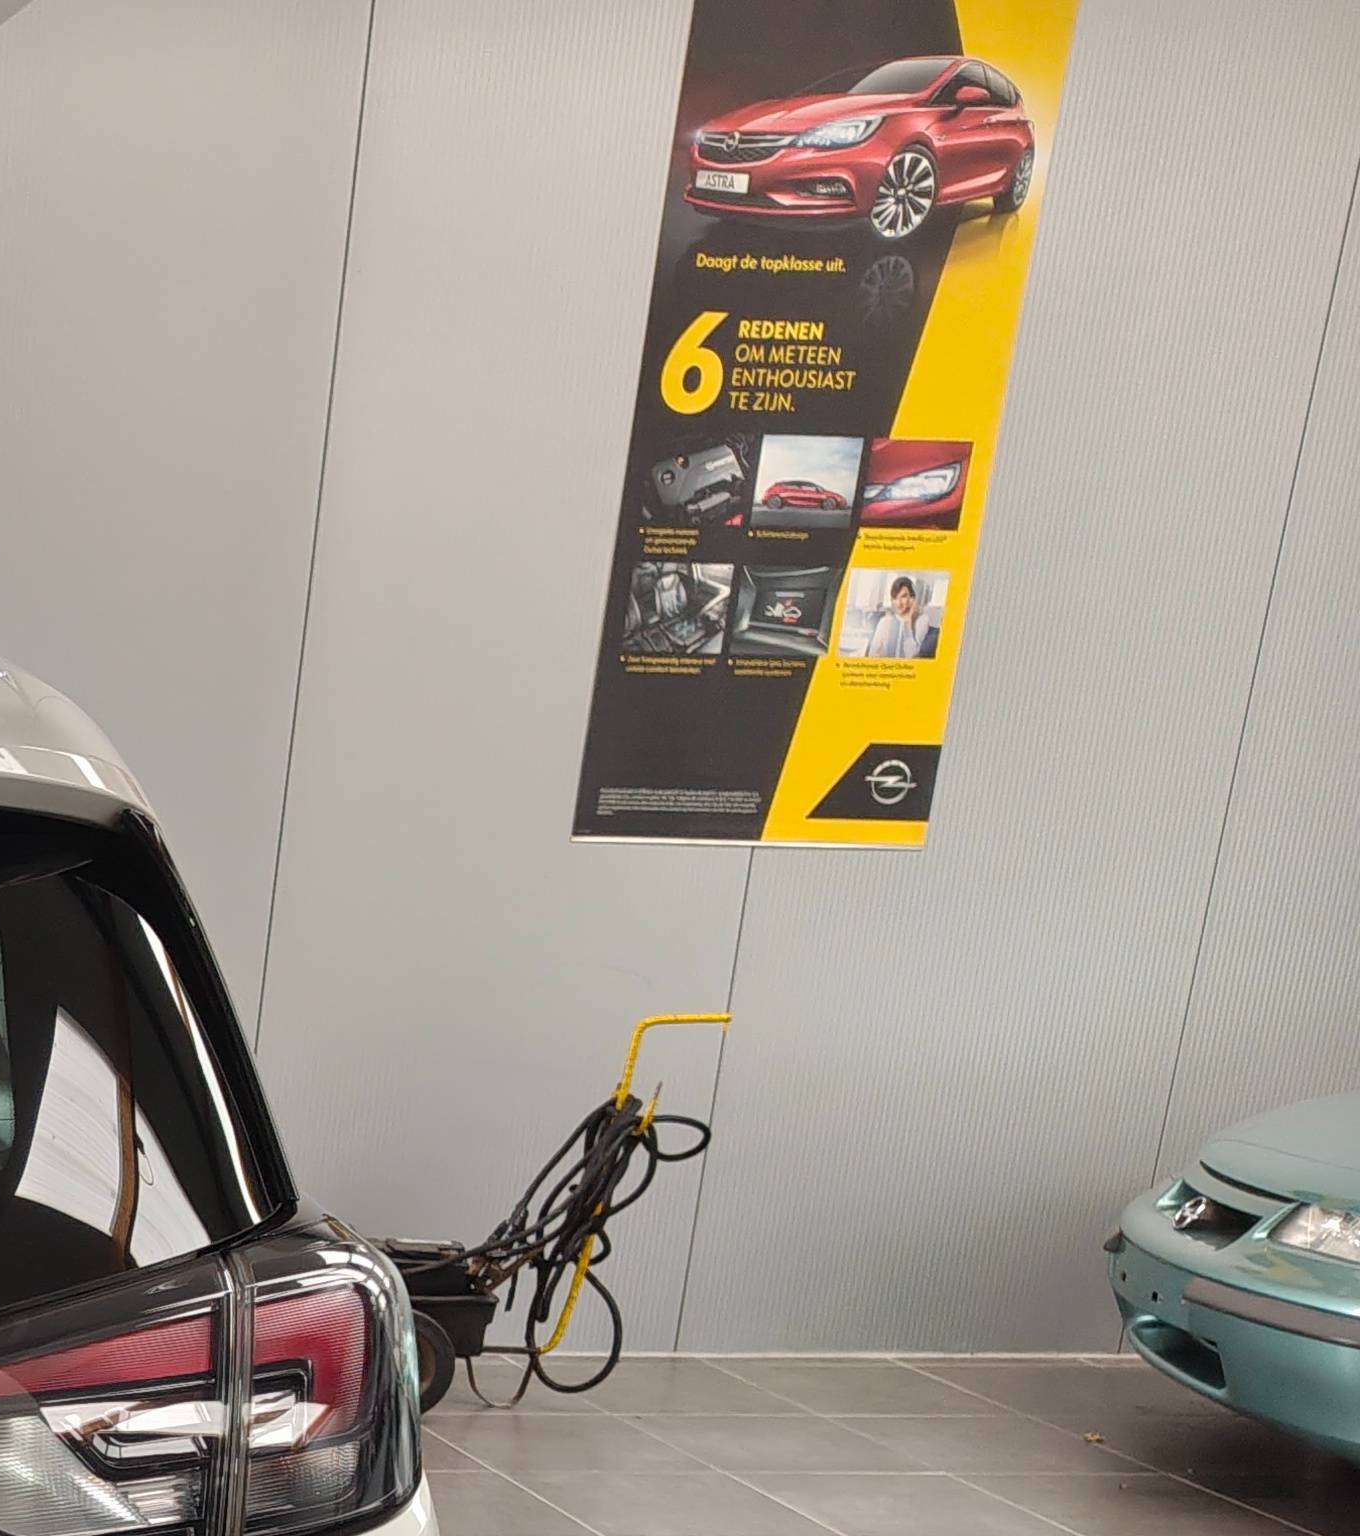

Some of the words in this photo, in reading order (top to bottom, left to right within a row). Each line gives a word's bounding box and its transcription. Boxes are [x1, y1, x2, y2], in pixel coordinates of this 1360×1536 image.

[704, 173, 735, 190] ASTRA
[696, 252, 737, 272] Daagt
[740, 253, 758, 270] de
[760, 255, 824, 273] topklasse
[826, 257, 847, 273] uit.
[737, 319, 825, 341] REDENEN
[660, 311, 730, 416] 6
[734, 343, 766, 363] OM
[768, 344, 842, 366] METEEN
[731, 366, 857, 390] ENTHOUSIAST
[729, 391, 750, 411] TE
[752, 392, 797, 412] ZIJN.
